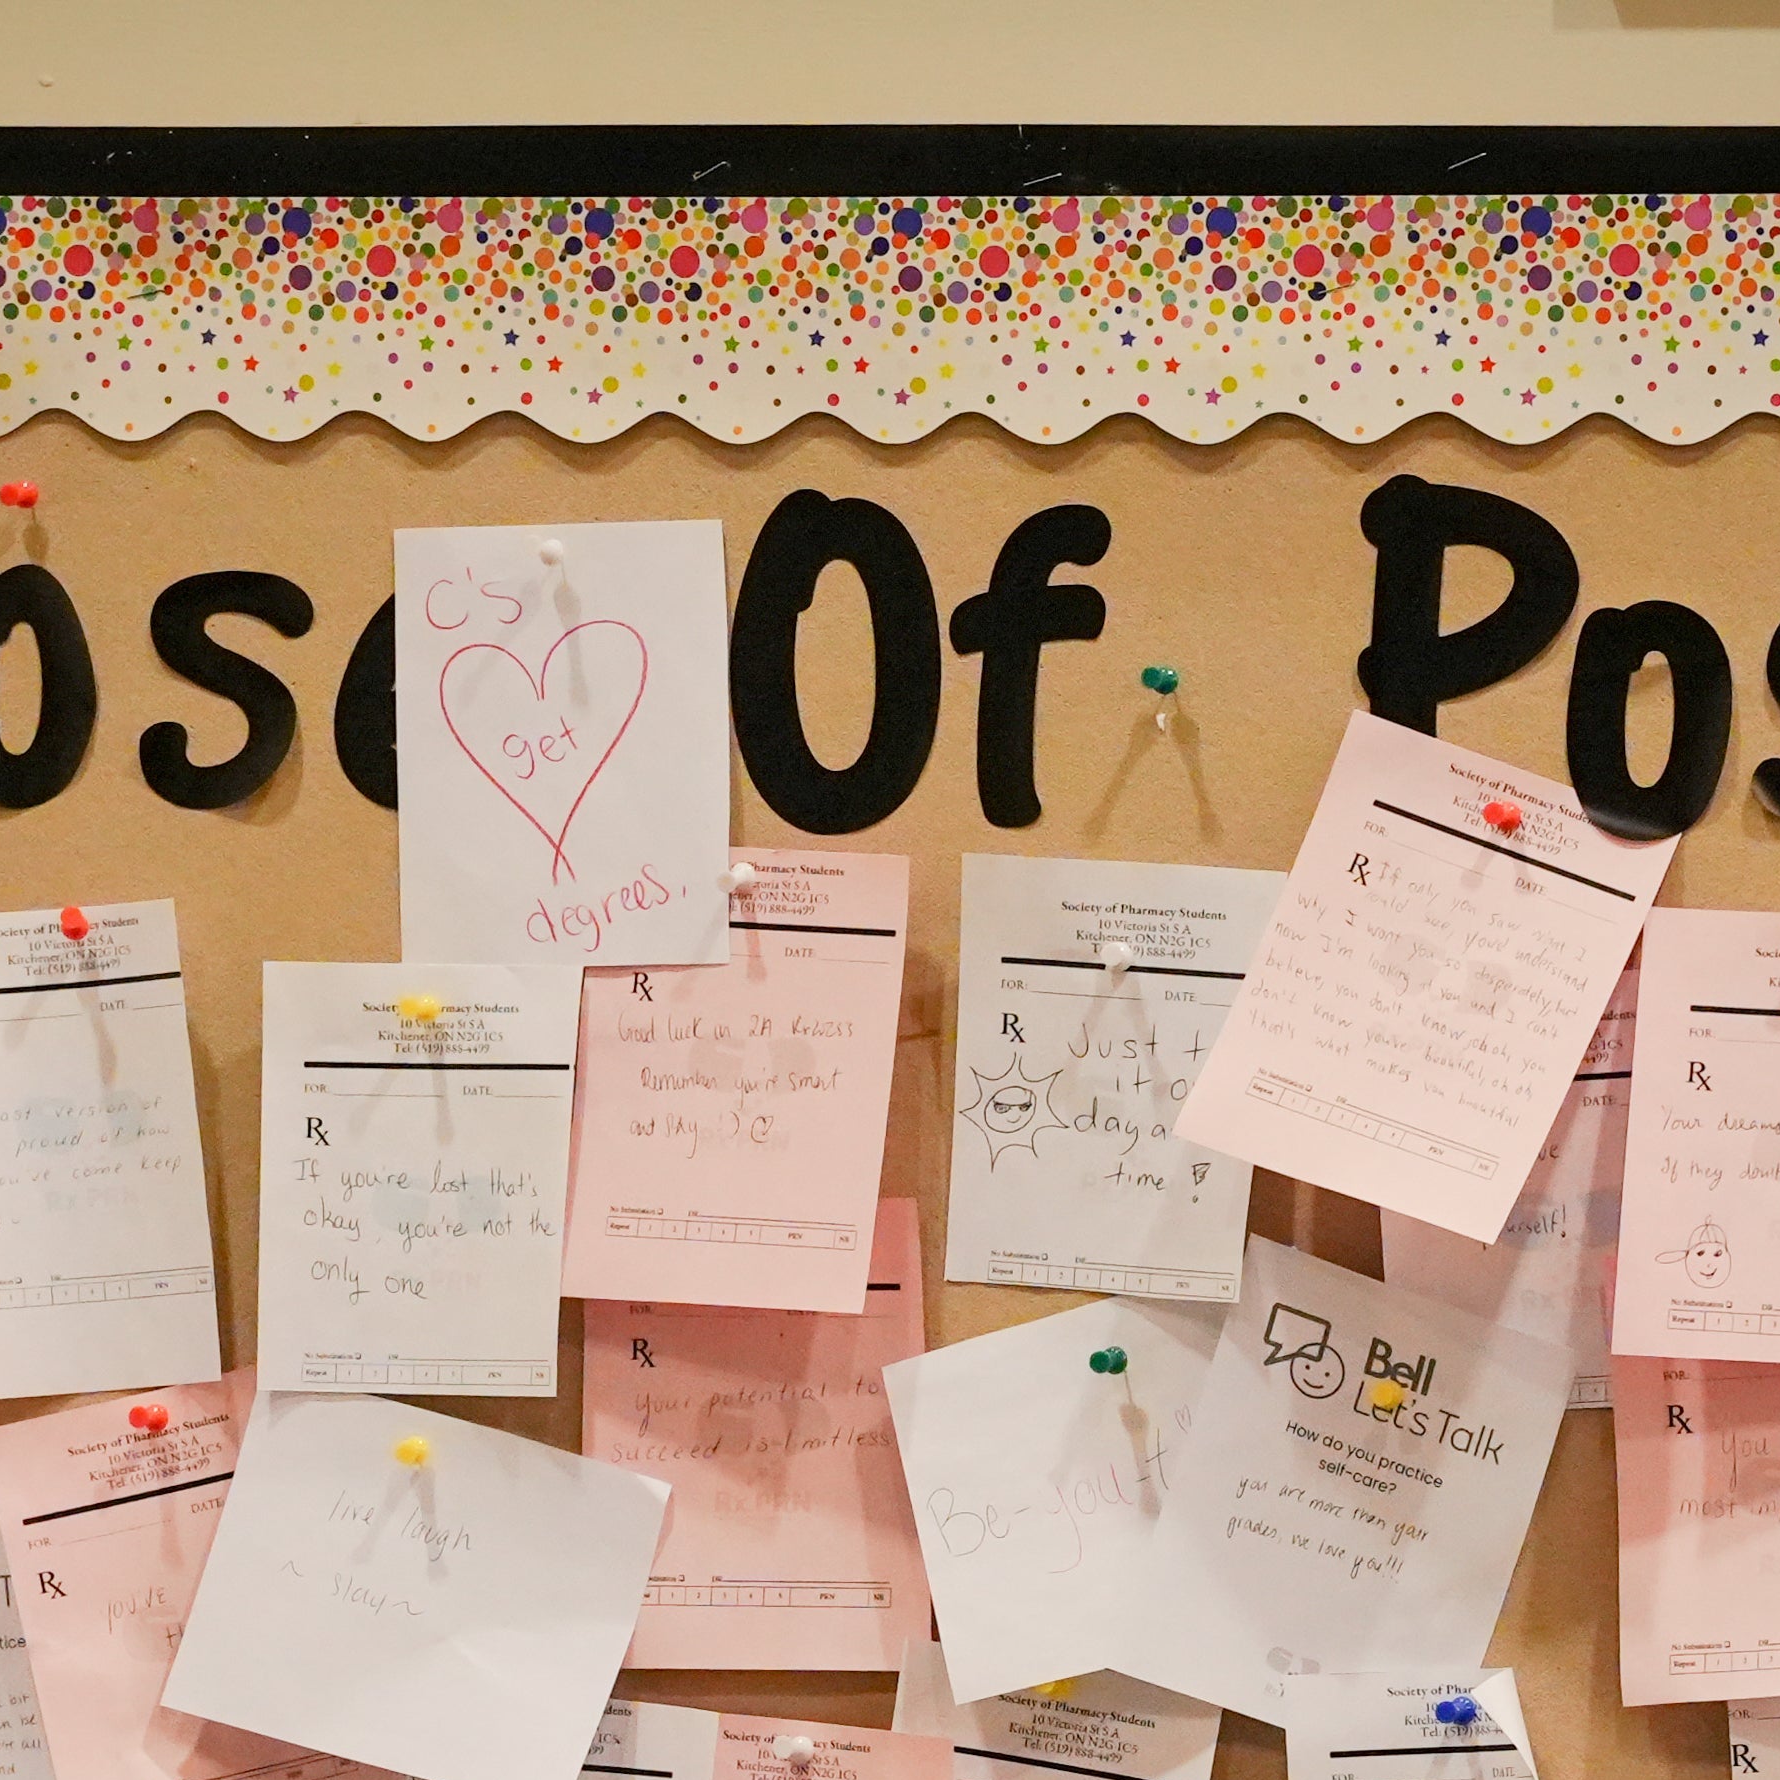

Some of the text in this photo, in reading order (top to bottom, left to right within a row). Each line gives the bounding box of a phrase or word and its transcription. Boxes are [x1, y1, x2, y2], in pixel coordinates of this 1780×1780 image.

[426, 567, 523, 630] C's
[729, 488, 1113, 834] Of
[502, 716, 579, 779] get
[1061, 901, 1227, 921] Society of Pharmacy Students
[1098, 918, 1110, 930] 10
[1114, 919, 1156, 933] Victoria
[1173, 923, 1180, 934] S
[1183, 925, 1191, 935] A
[1135, 933, 1154, 944] ON
[1159, 935, 1185, 947] N2G
[1190, 937, 1211, 948] 1C5
[1068, 1023, 1159, 1058] Just
[1115, 1064, 1153, 1094] it
[1073, 1096, 1139, 1156] day
[1661, 1105, 1703, 1131] Your
[294, 1158, 320, 1181] If
[341, 1166, 410, 1201] you're
[490, 1168, 537, 1197] that's
[1690, 1160, 1723, 1190] they
[398, 1215, 468, 1253] you're
[482, 1218, 512, 1234] not
[530, 1208, 557, 1237] the
[311, 1256, 427, 1305] only one
[1363, 1337, 1437, 1396] Bell
[1285, 1420, 1443, 1488] How do you practice
[1439, 1409, 1505, 1465] Talk
[1279, 1485, 1305, 1501] are
[1319, 1458, 1397, 1495] self-care?
[1319, 1539, 1346, 1559] love
